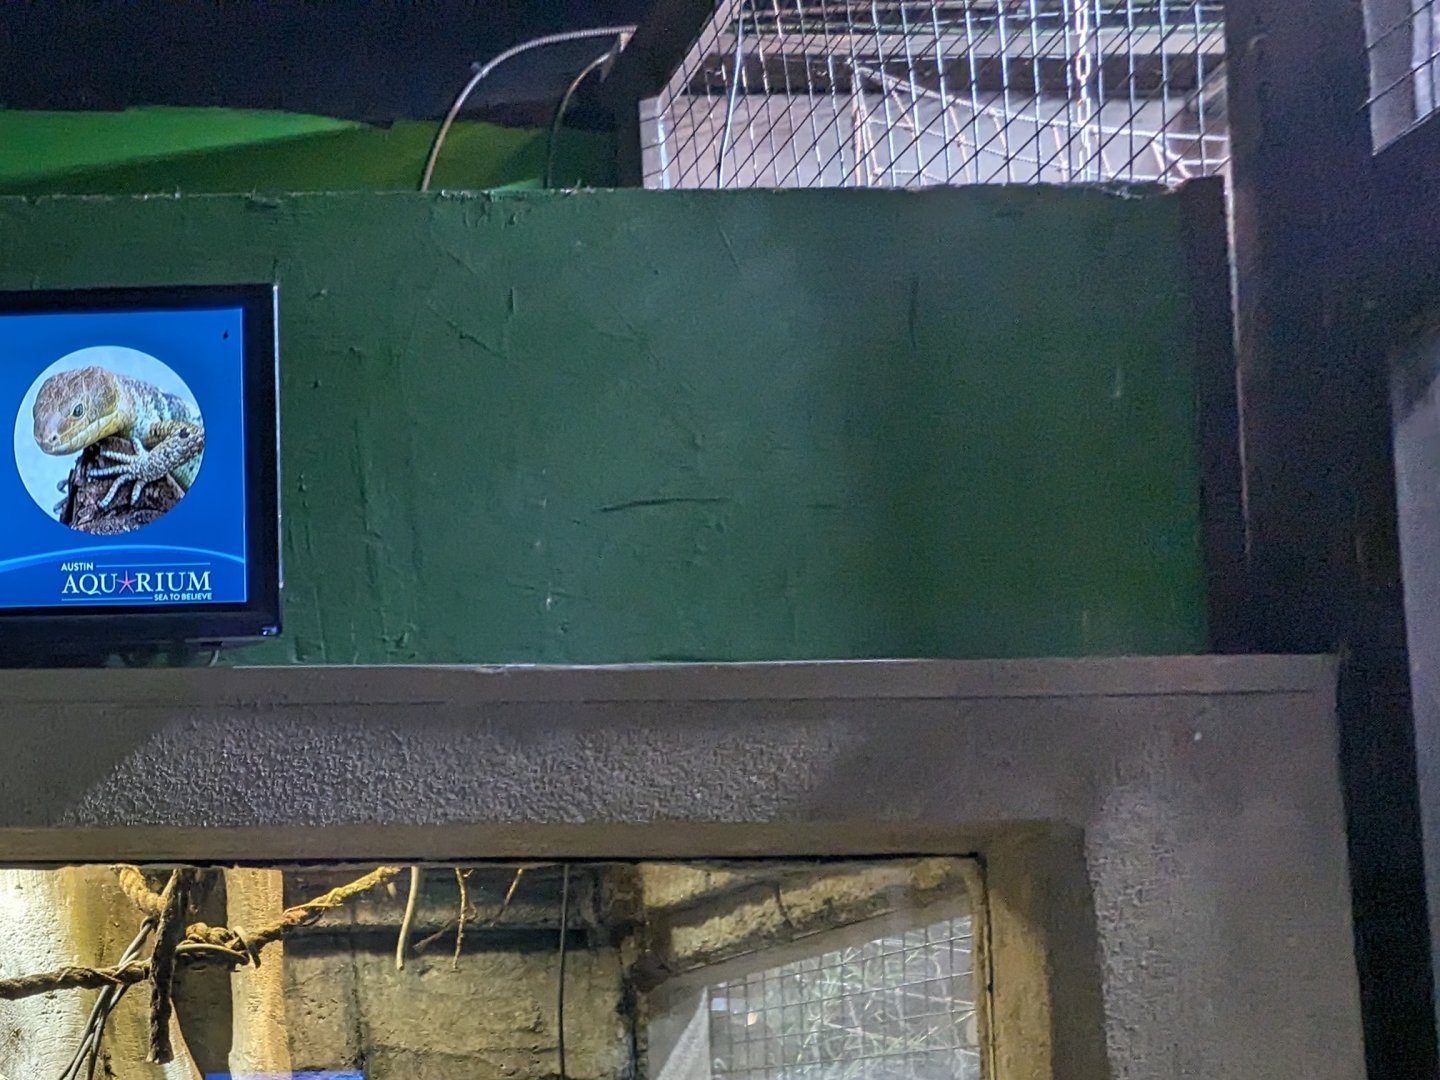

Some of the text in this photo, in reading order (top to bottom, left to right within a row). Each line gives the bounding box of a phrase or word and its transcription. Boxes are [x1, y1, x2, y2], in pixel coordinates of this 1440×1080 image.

[61, 562, 94, 571] AUSTIN
[170, 593, 180, 601] TO
[181, 592, 212, 600] BELIEVE
